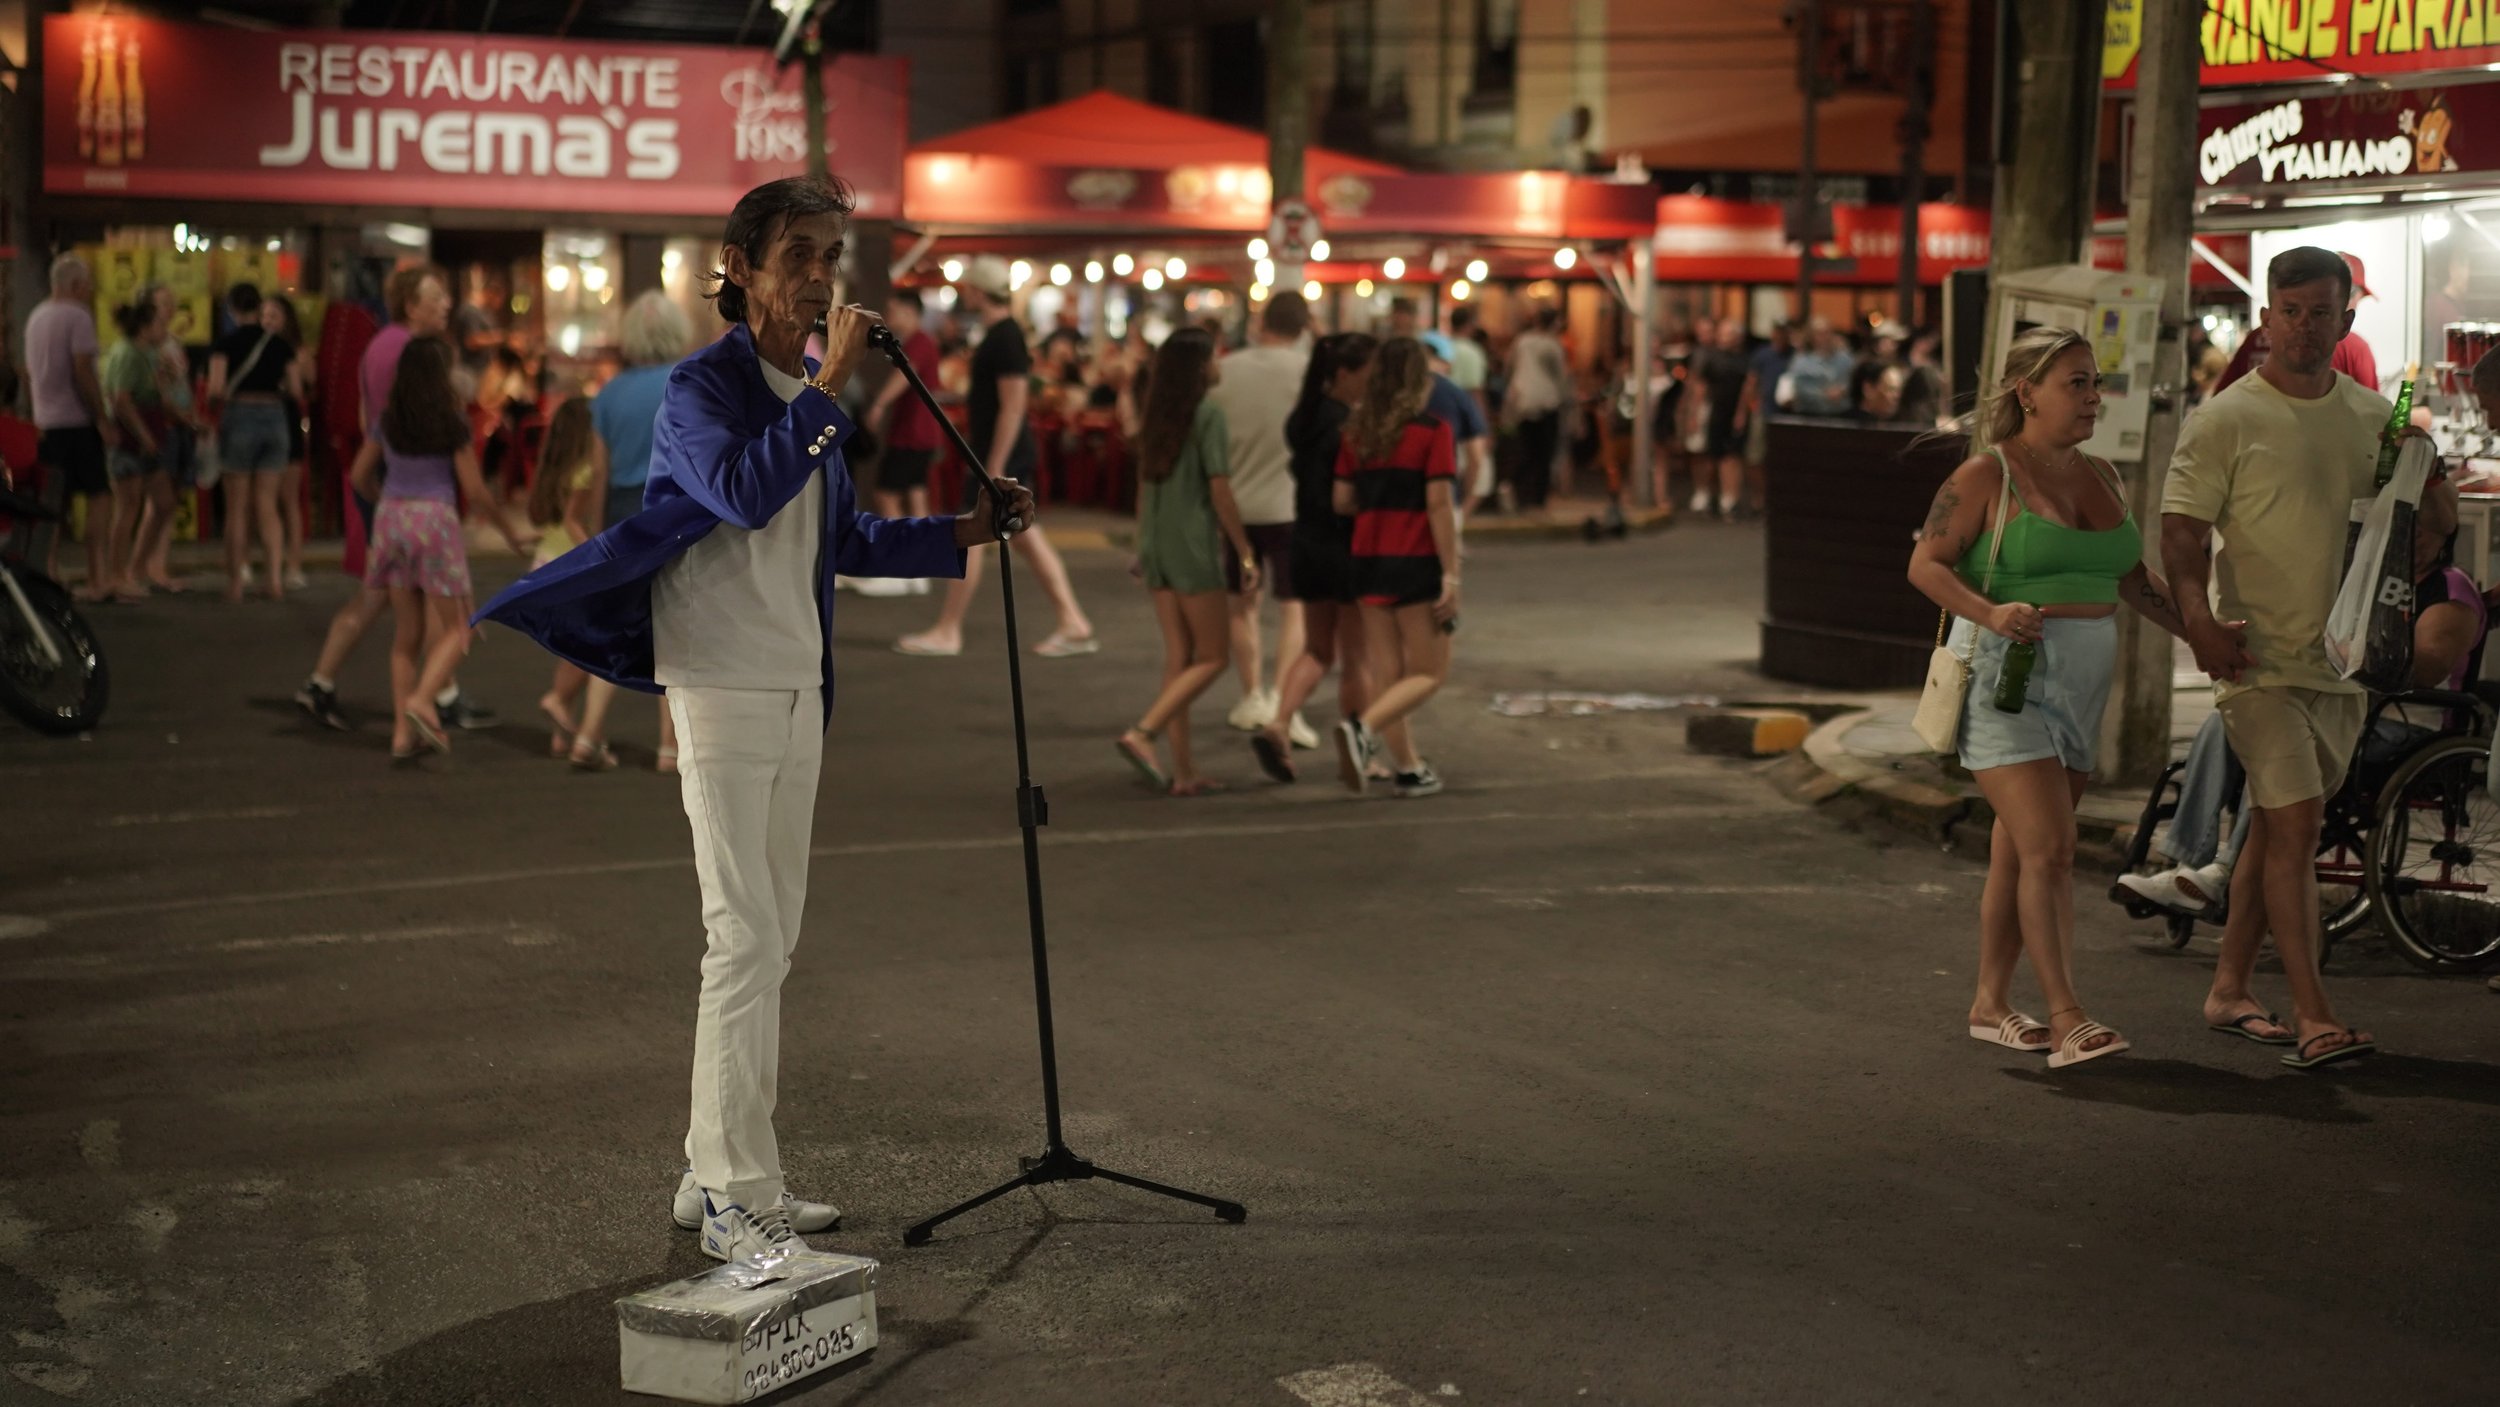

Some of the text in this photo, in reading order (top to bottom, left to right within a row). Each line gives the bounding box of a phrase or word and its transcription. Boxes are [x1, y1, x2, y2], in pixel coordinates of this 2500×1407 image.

[280, 42, 681, 108] RESTAURANTE
[735, 118, 838, 163] 198
[2200, 99, 2303, 185] Churros
[2257, 135, 2413, 182] YTALIANO
